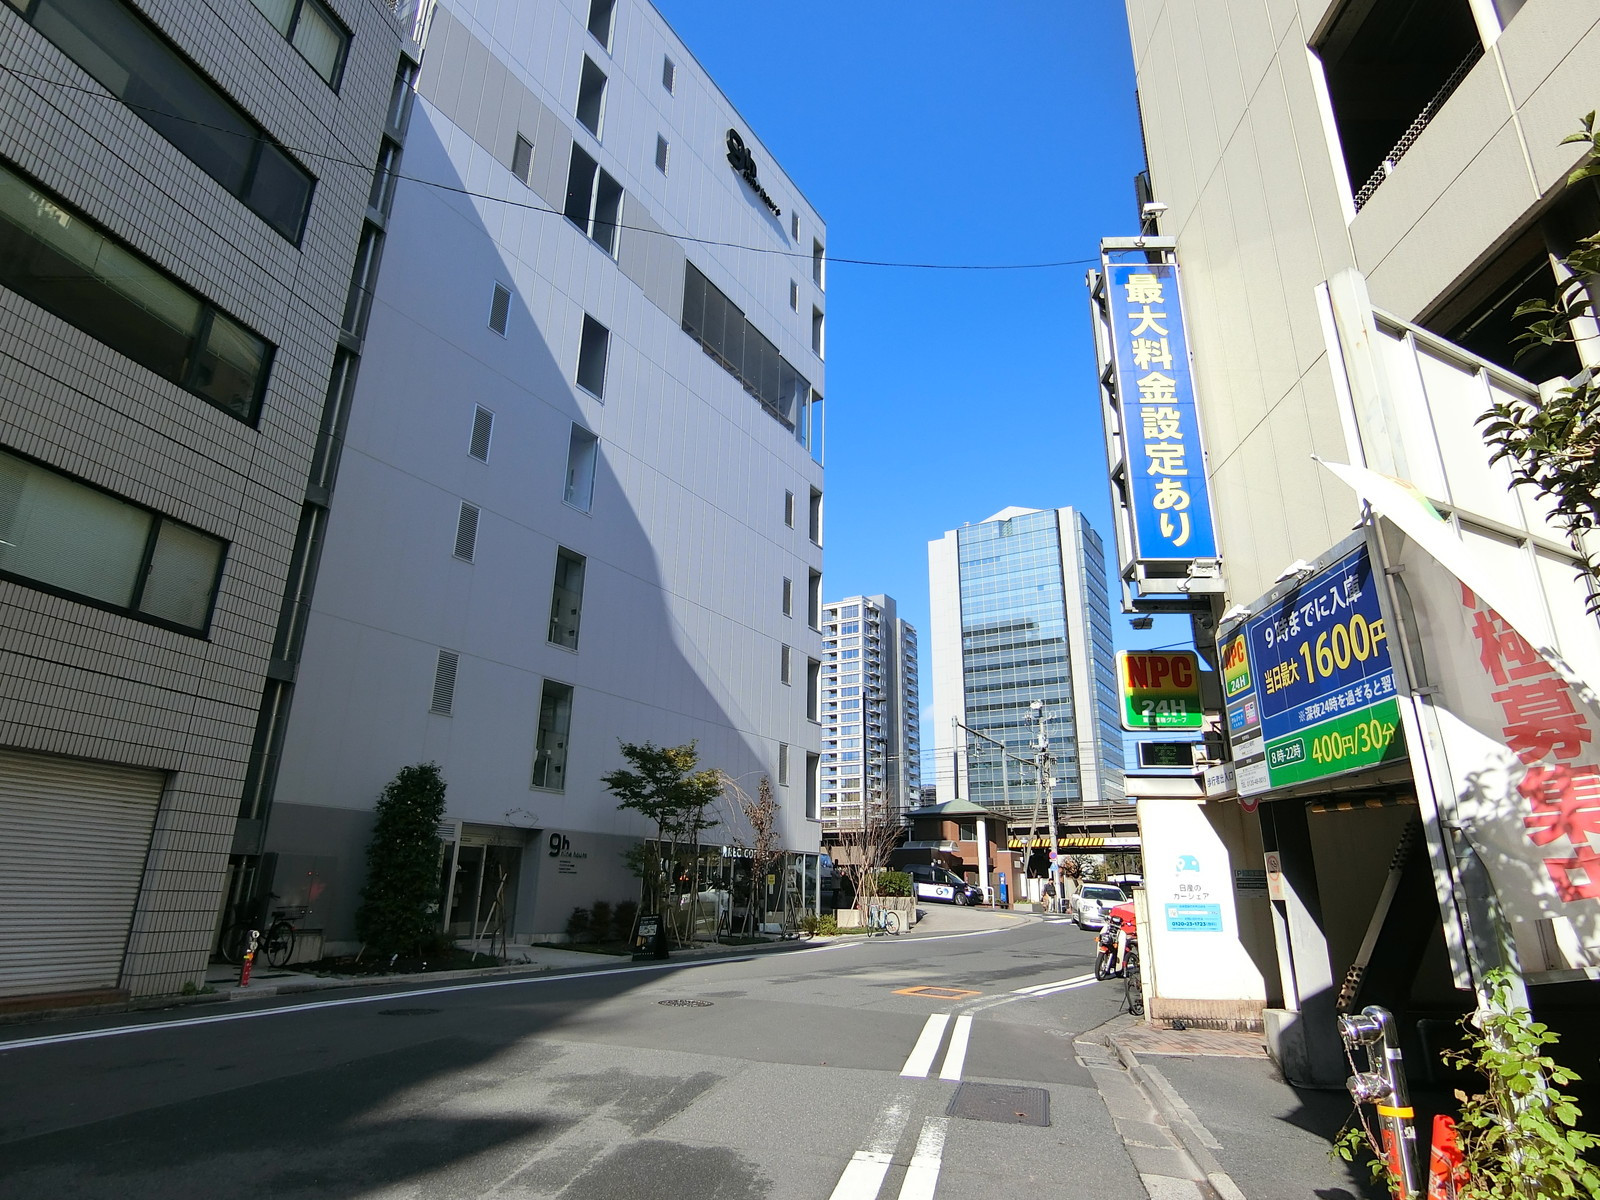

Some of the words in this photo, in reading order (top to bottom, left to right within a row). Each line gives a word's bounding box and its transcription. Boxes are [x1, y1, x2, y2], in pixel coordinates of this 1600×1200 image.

[1124, 274, 1190, 547] 最大料金設定あり
[1265, 574, 1362, 649] 9時までに入庫
[1224, 641, 1245, 670] NPC
[1264, 657, 1300, 695] 当日最大
[1300, 613, 1388, 684] 1600円
[1126, 656, 1193, 688] NPC
[1230, 675, 1246, 692] 24H
[1141, 699, 1187, 716] 24H
[1312, 719, 1396, 764] 400円/30分
[548, 832, 570, 858] 9h
[1173, 892, 1209, 900] カーシェア
[1179, 883, 1201, 892] 日産の
